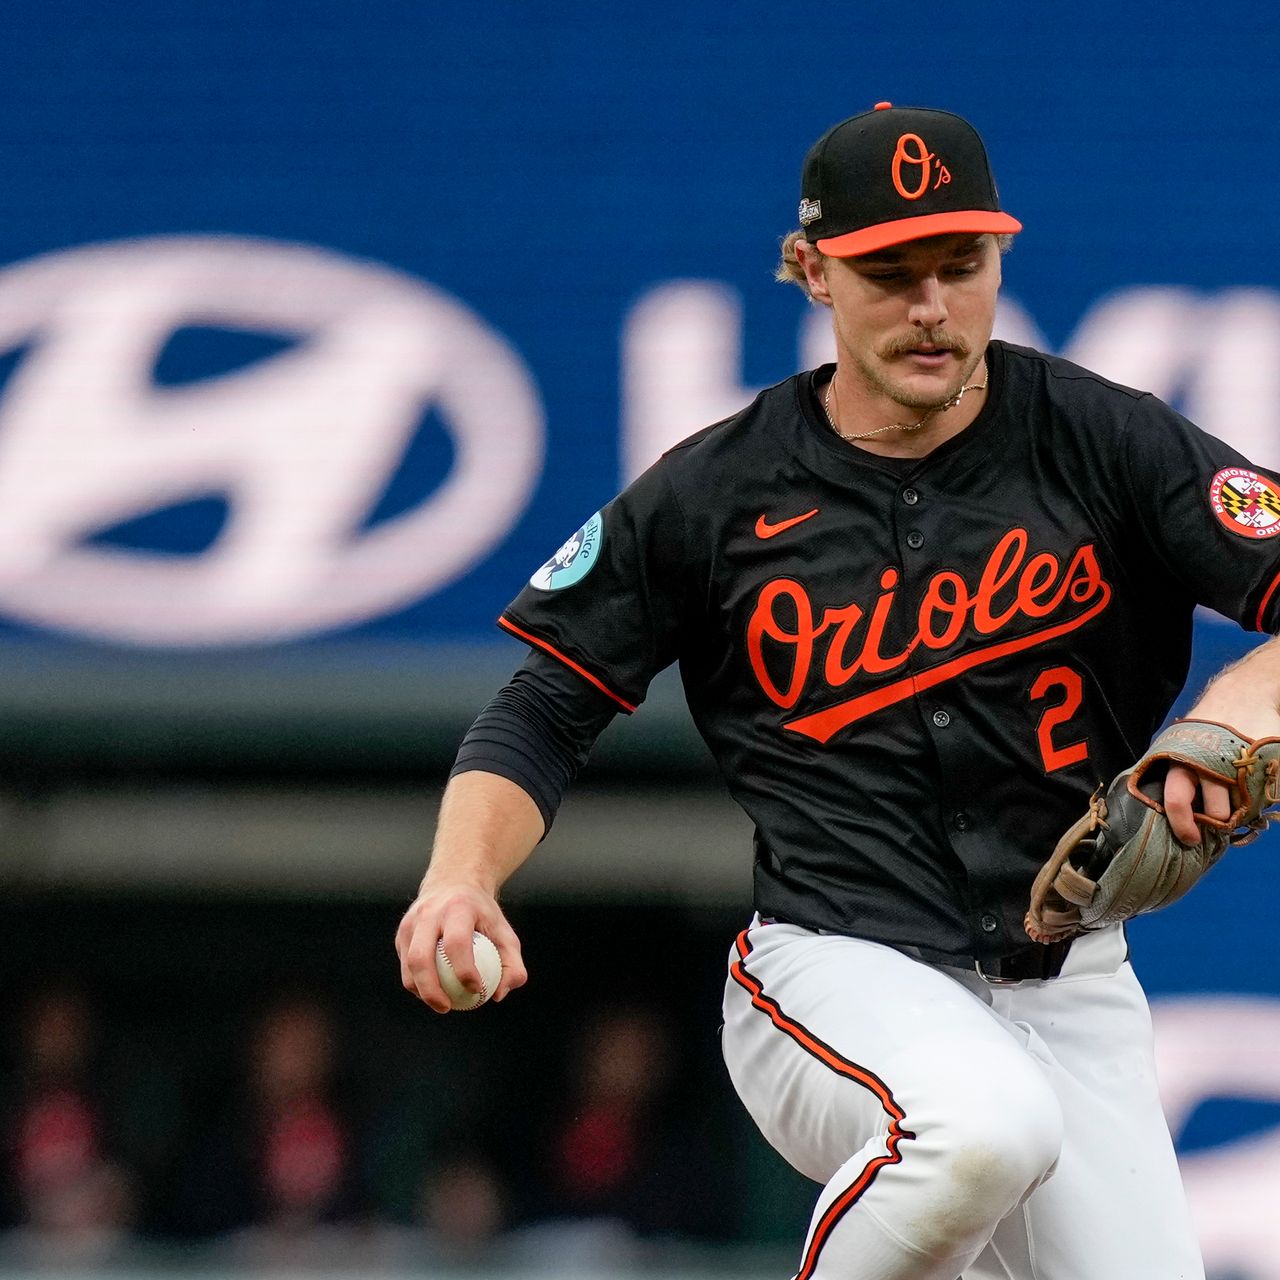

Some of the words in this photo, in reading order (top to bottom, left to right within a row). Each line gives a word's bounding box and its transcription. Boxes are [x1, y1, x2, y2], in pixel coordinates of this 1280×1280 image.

[891, 133, 952, 200] O's
[1212, 469, 1258, 514] BALTIMORE
[746, 527, 1112, 716] Orioles
[1030, 665, 1090, 773] 2
